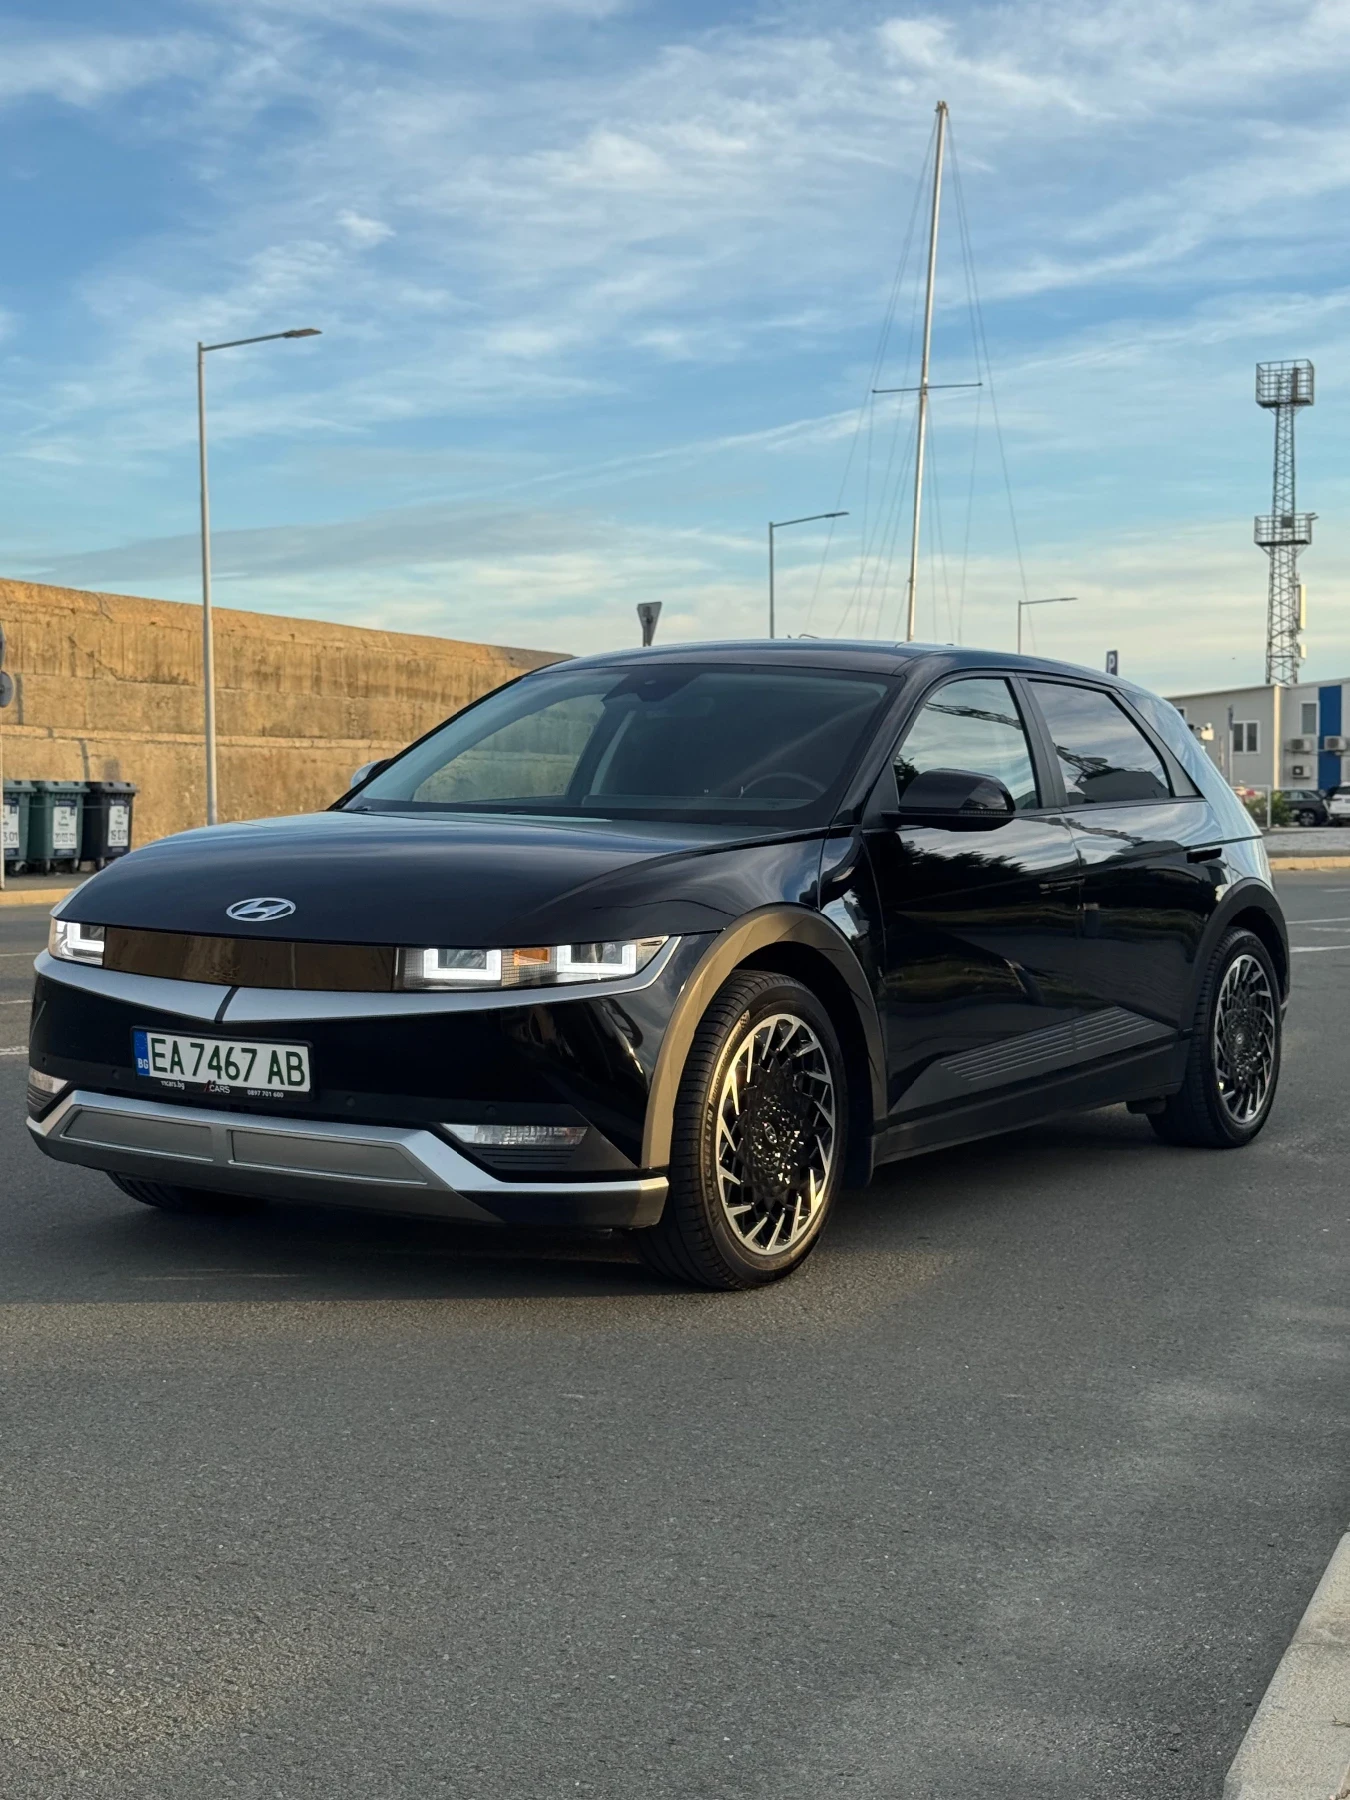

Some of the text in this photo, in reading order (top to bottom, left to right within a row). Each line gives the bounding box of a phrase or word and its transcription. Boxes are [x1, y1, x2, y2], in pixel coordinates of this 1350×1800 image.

[137, 1058, 149, 1070] BG
[150, 1037, 306, 1087] EA 7467 AB
[704, 1109, 716, 1200] MICHELIN
